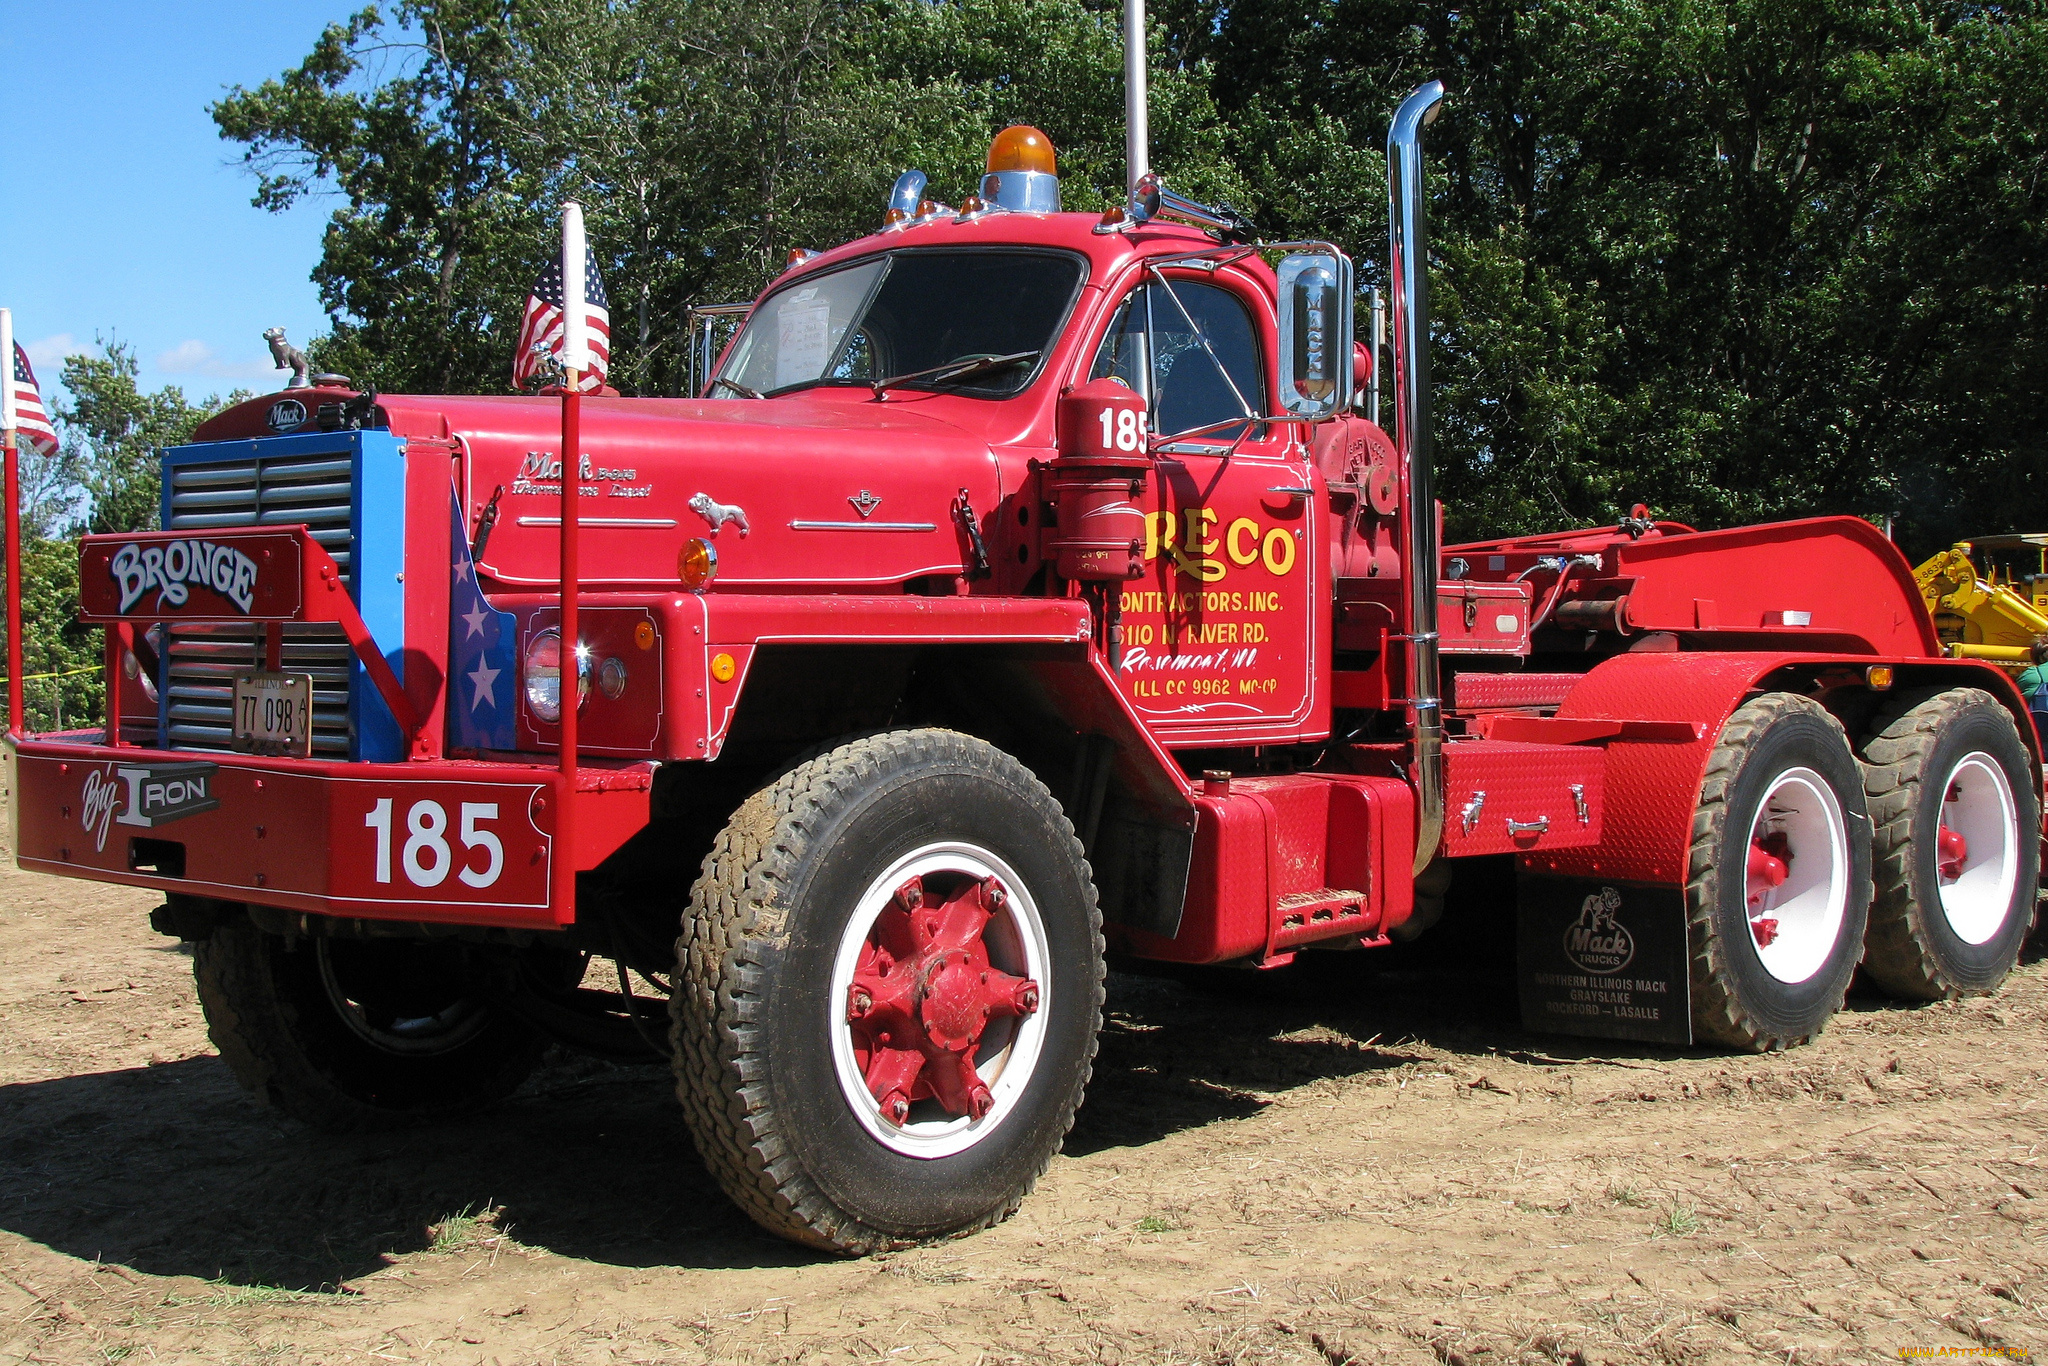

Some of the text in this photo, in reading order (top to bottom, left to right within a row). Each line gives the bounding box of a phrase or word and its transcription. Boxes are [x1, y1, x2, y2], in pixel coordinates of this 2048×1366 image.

[268, 403, 300, 427] Mack
[1099, 407, 1147, 454] 185
[516, 451, 593, 480] Mak
[512, 480, 599, 496] Thermoyne
[111, 540, 258, 615] BRONGE
[1187, 623, 1239, 645] RIVER
[1243, 622, 1269, 643] RD.
[1133, 679, 1162, 698] ILL
[1166, 679, 1187, 695] CC
[1192, 678, 1231, 695] 9962
[241, 695, 258, 731] 77
[265, 697, 293, 733] 098
[82, 761, 206, 853] Big IRON
[365, 797, 505, 889] 185
[1570, 927, 1629, 956] Mack
[1579, 953, 1621, 966] TRUCKS
[1535, 972, 1667, 994] NORTHERN ILLINOIS MACK
[1570, 989, 1630, 1005] GRAYSLAKE
[1546, 1002, 1599, 1016] ROCKFORD
[1614, 1006, 1660, 1020] LASALLE
